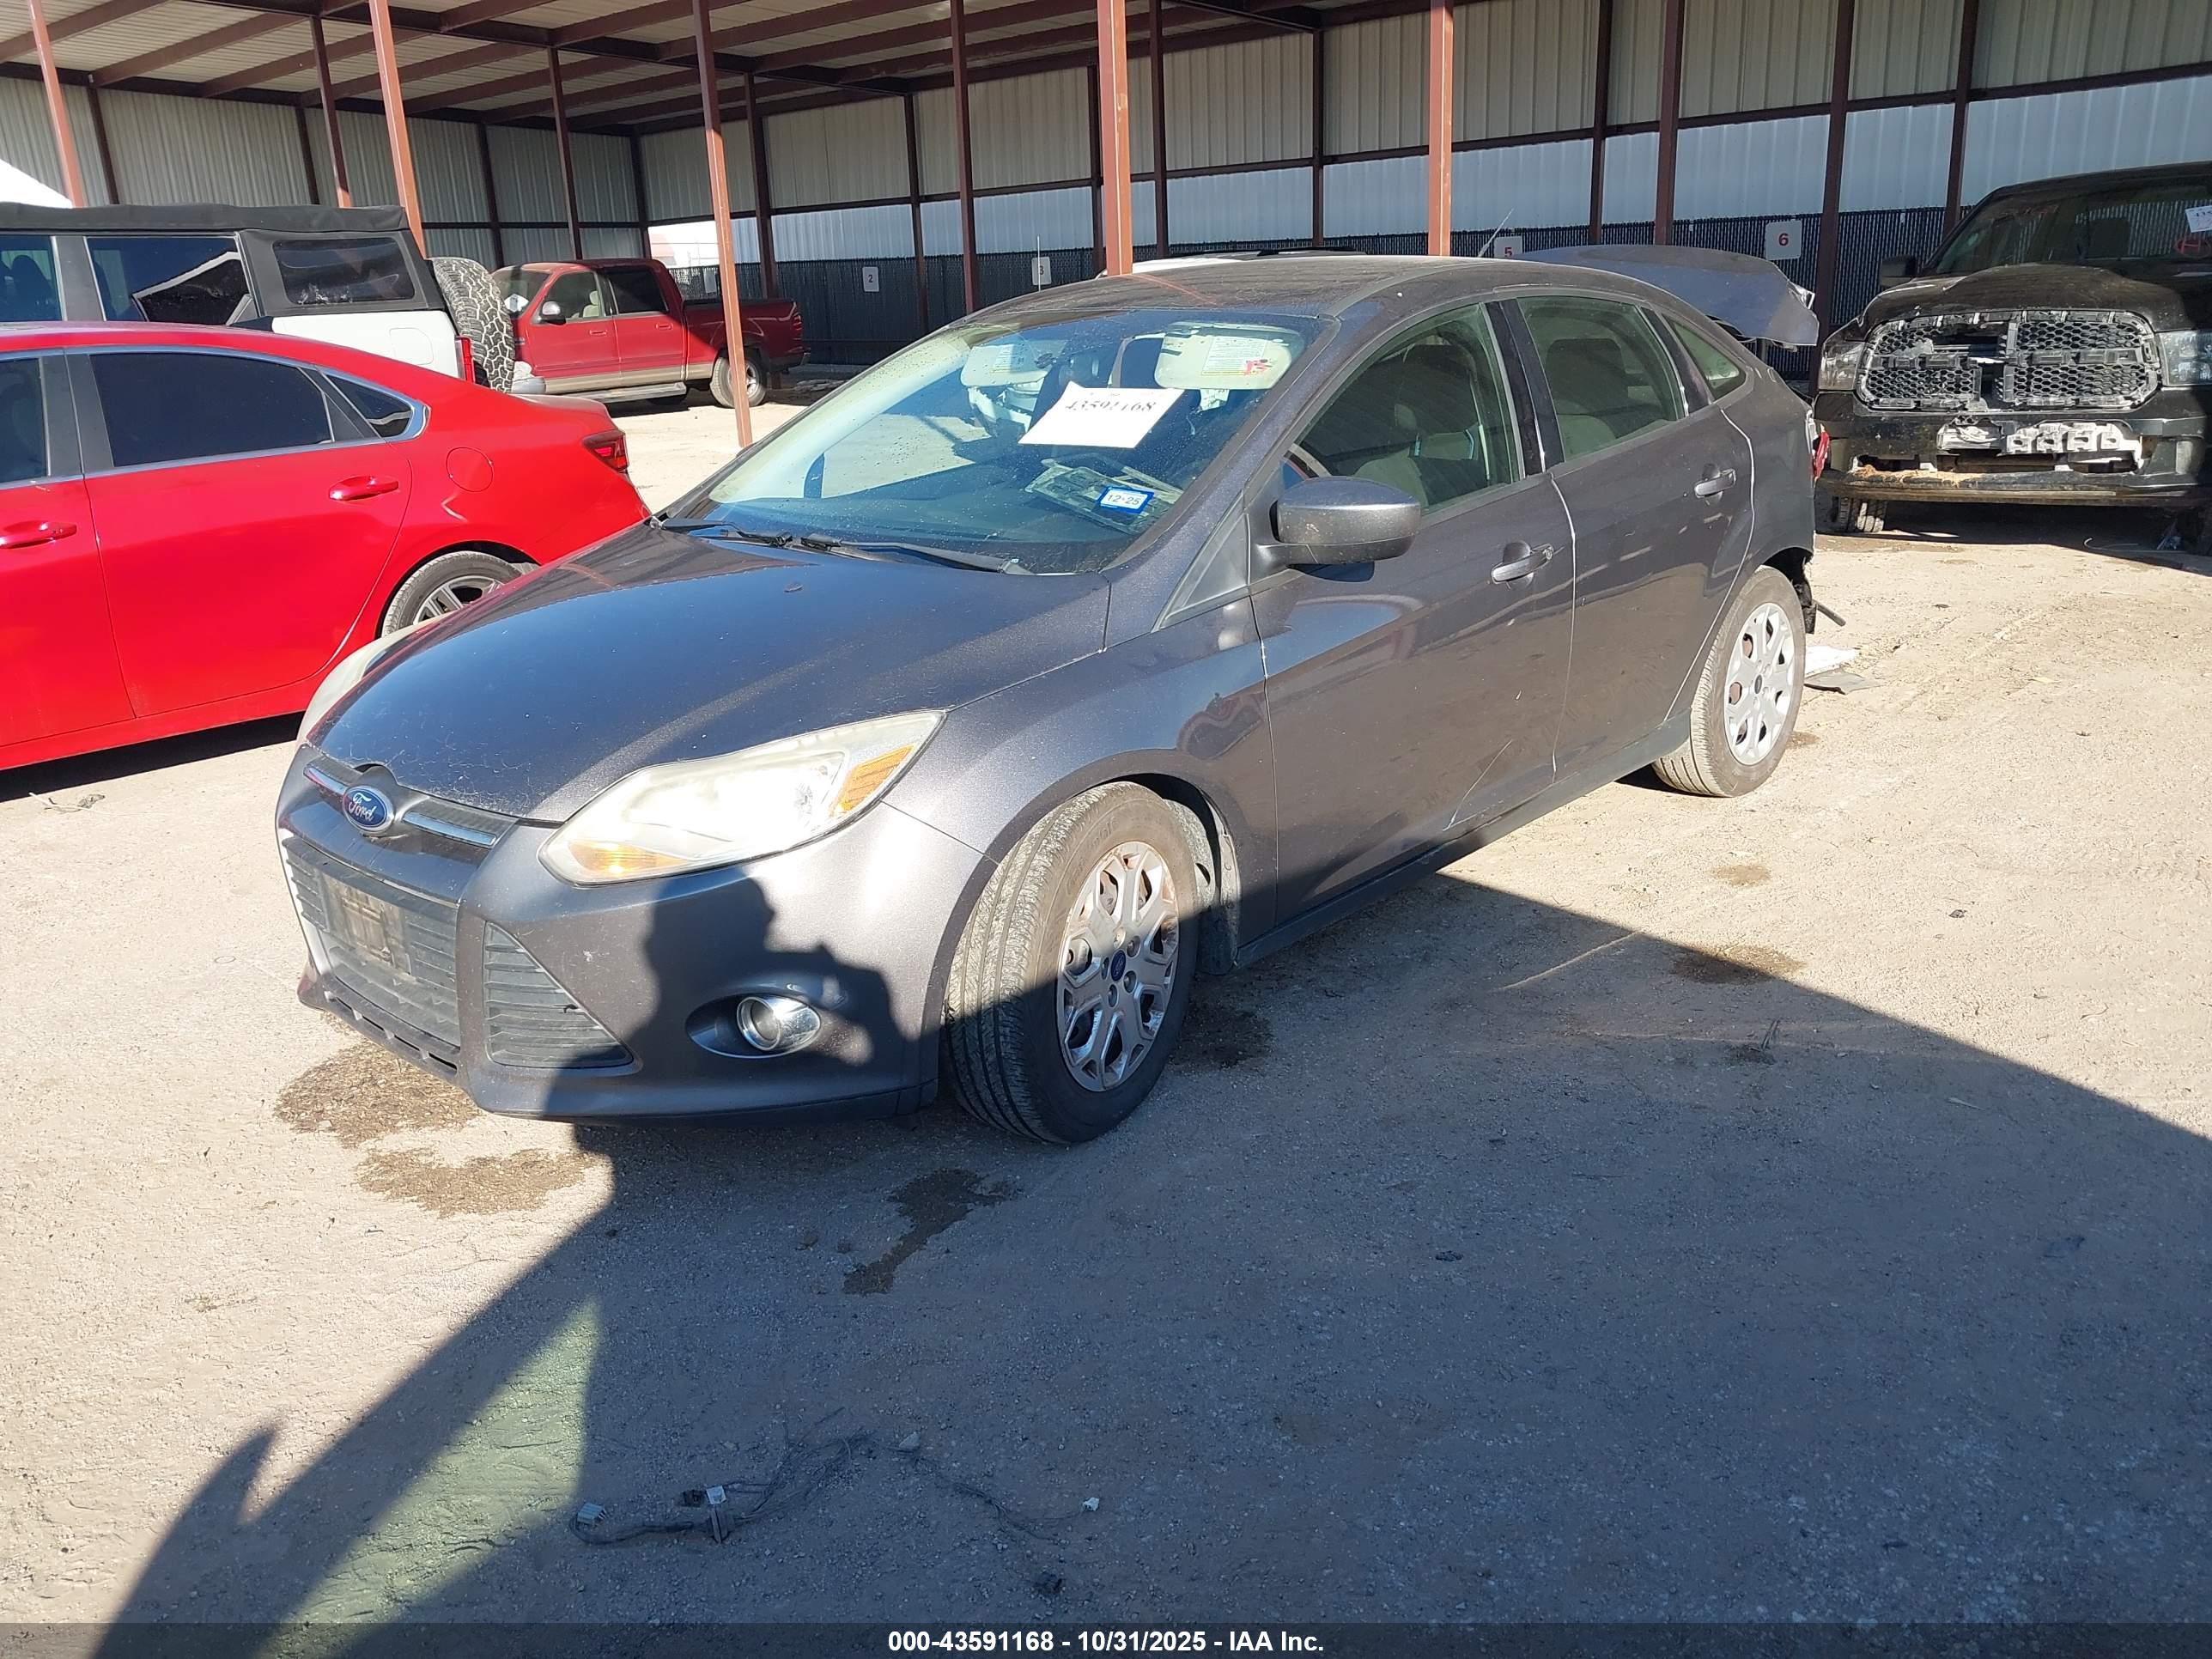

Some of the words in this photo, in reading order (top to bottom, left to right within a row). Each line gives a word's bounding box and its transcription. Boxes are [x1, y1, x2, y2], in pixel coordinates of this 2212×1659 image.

[1778, 233, 1789, 246] 6
[868, 274, 873, 283] 2
[348, 792, 377, 822] Ford
